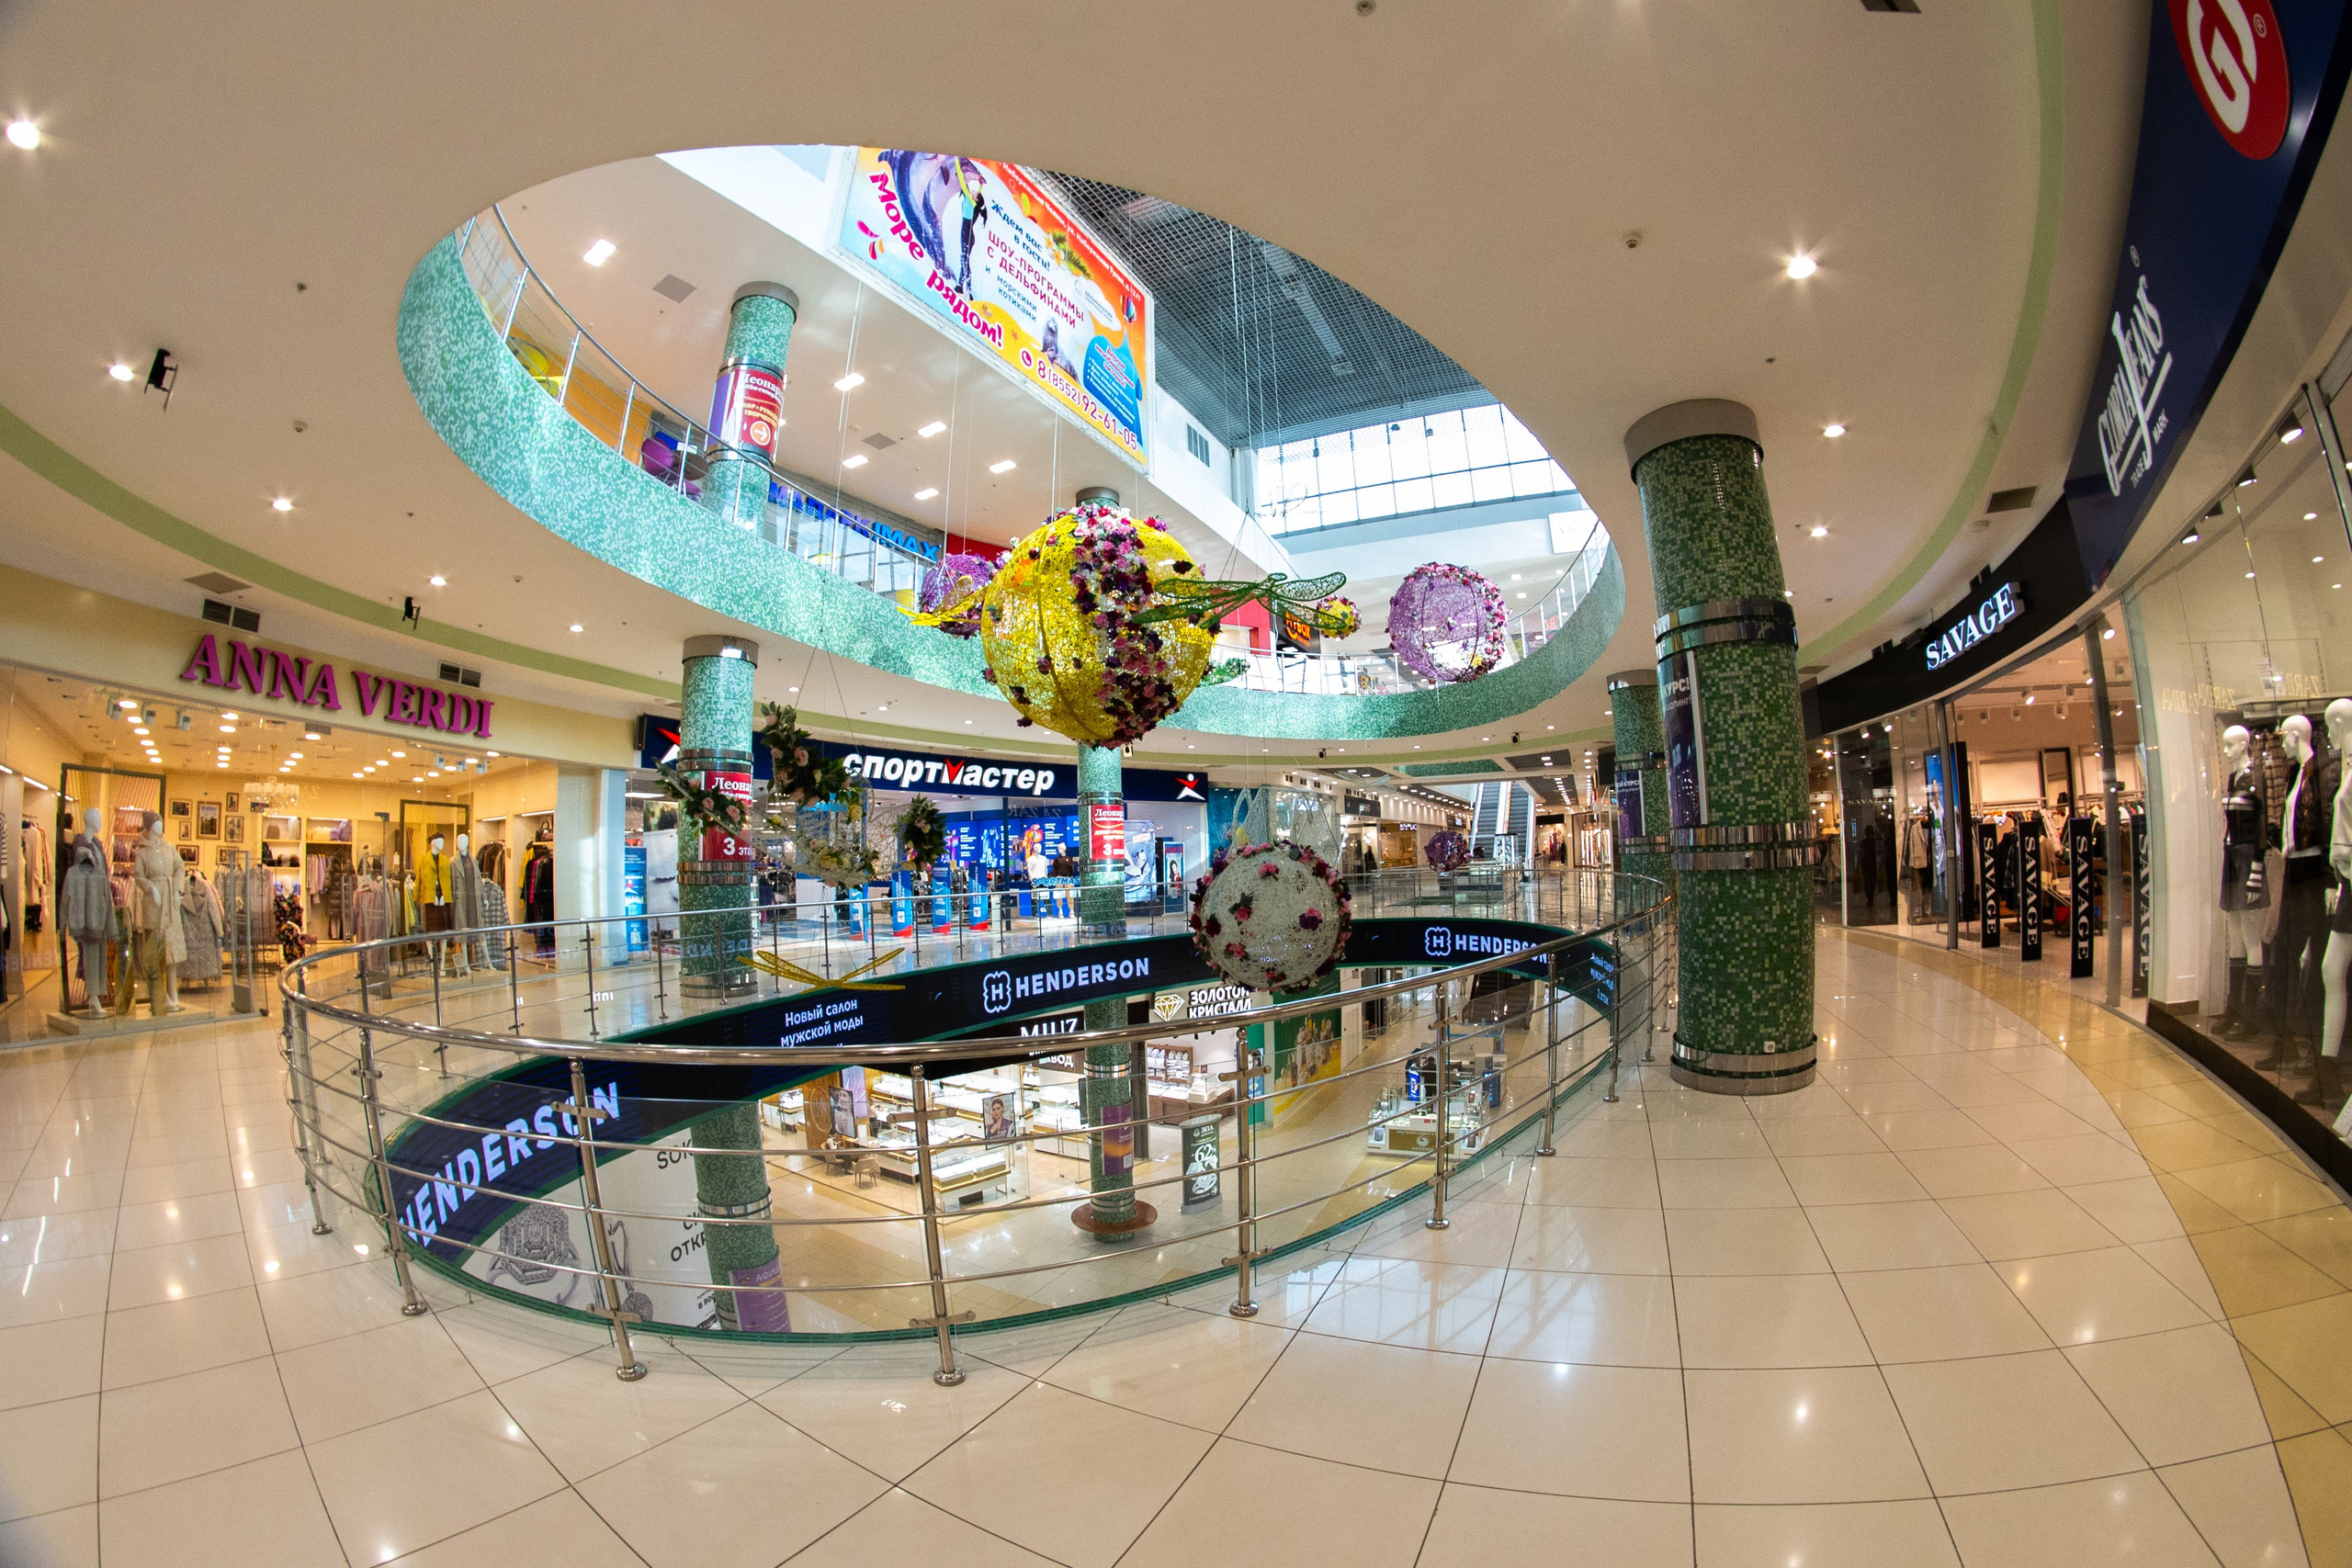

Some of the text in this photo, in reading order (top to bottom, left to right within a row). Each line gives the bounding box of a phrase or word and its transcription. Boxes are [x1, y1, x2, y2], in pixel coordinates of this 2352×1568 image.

[868, 172, 924, 262] Море
[991, 198, 1043, 253] Ждем вас
[1013, 234, 1050, 272] в гости!
[985, 265, 1037, 312] и морскими
[989, 231, 1084, 321] ШОУ-ПРОГРАММЫ
[999, 256, 1076, 329] ДЕЛЬФИНАМИ
[926, 269, 1003, 348] рядом!
[998, 288, 1036, 322] котиками
[2153, 409, 2169, 446] MARK
[1926, 581, 2018, 671] SAVAGE
[180, 633, 496, 738] ANNA VERDI
[842, 753, 1056, 796] спортмастер
[723, 836, 736, 855] 3
[1102, 843, 1113, 856] 3
[1032, 876, 1080, 886] SPORTMAS
[1984, 837, 1997, 934] SAVAGE
[2024, 836, 2038, 946] SAVAGE
[2075, 835, 2089, 960] SAVAGE
[1016, 957, 1149, 998] HENDERSON
[780, 1015, 864, 1047] мужской моды
[786, 999, 857, 1027] Новый салон
[1189, 998, 1251, 1019] КРИСТАЛЛ
